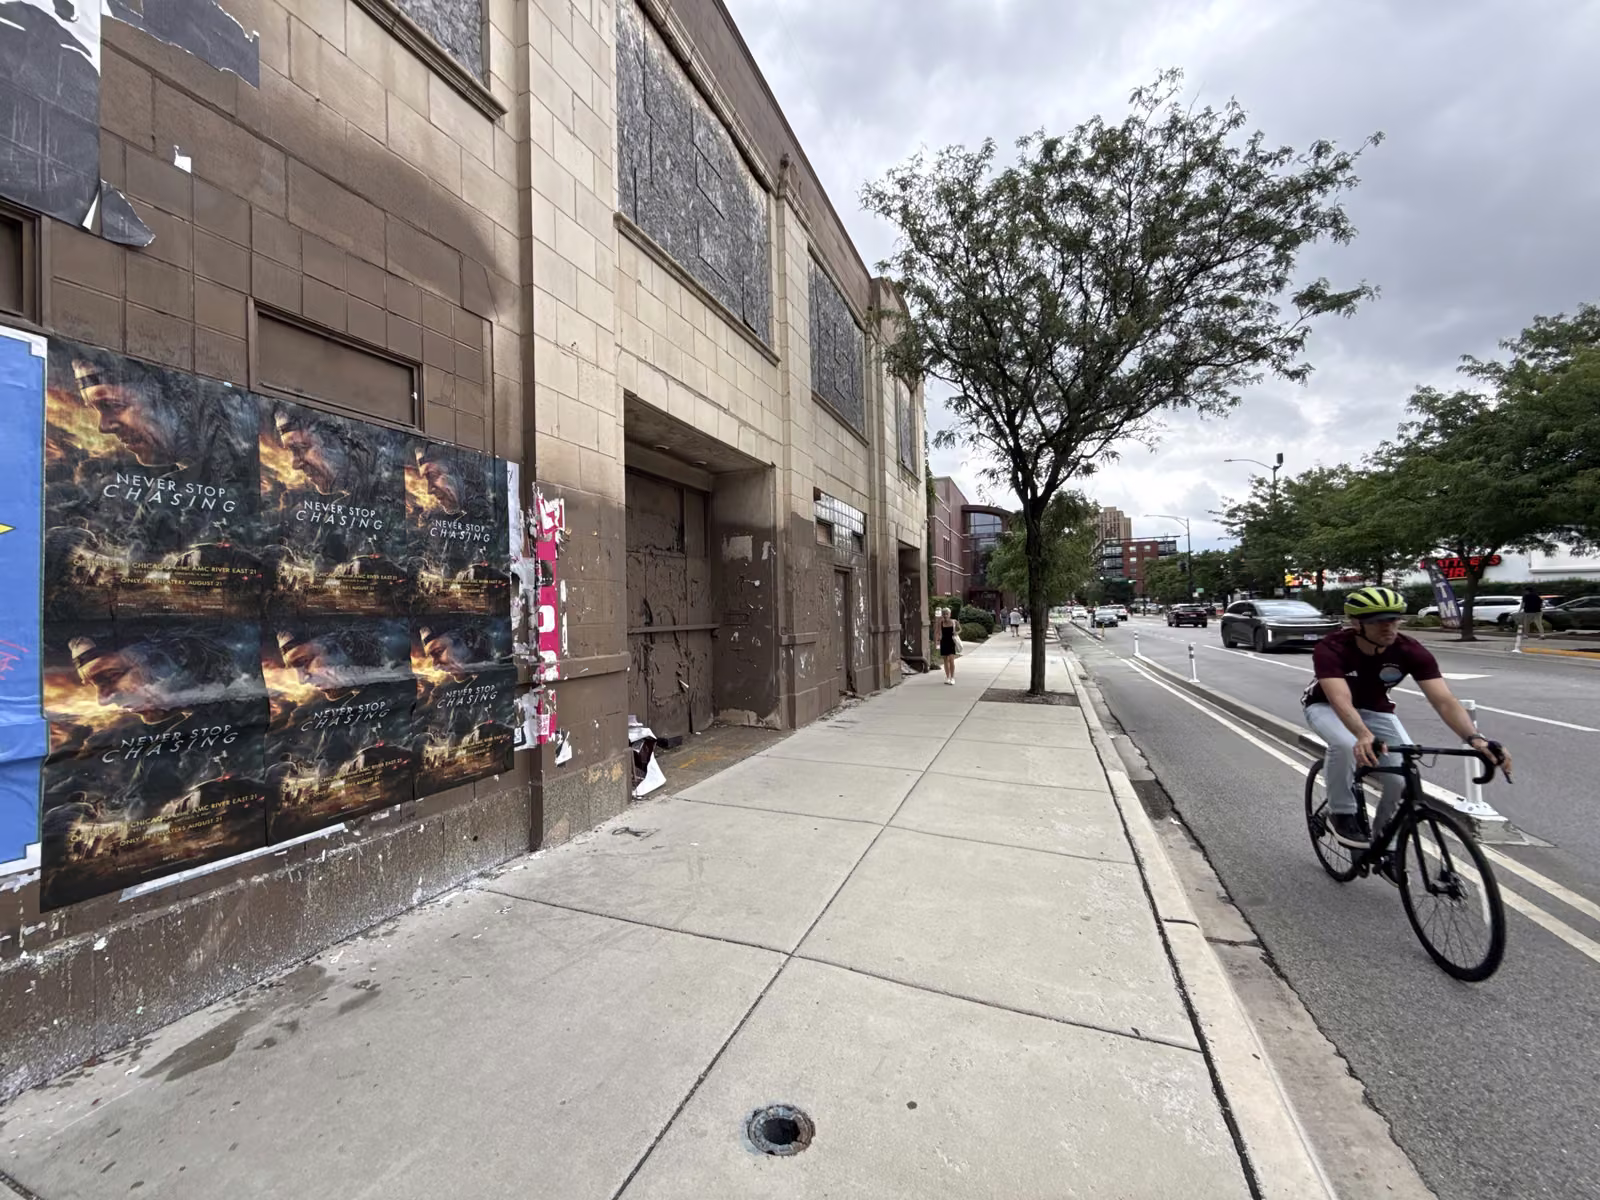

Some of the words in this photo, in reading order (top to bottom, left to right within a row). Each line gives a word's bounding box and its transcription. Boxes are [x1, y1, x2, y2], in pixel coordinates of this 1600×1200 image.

[116, 472, 176, 491] NEVER
[185, 483, 226, 498] STOP
[103, 484, 236, 513] CHASING
[303, 500, 343, 514] NEVER
[349, 506, 376, 518] STOP
[296, 510, 383, 530] CHASING
[435, 519, 462, 530] NEVER
[465, 523, 485, 533] STOP
[430, 527, 490, 543] CHASING
[132, 562, 171, 571] CHICAGO
[436, 691, 498, 709] CHASING
[446, 687, 473, 699] NEVER
[476, 684, 496, 694] STOP
[301, 709, 390, 732] CHASING
[313, 706, 353, 720] NEVER
[358, 701, 386, 713] STOP
[120, 732, 182, 748] NEVER
[190, 724, 232, 739] STOP
[102, 732, 239, 763] CHASING
[130, 814, 170, 828] CHICAGO
[192, 805, 210, 814] AMC
[211, 800, 231, 809] RIVER
[232, 796, 249, 805] EAST
[249, 793, 258, 801] 21
[119, 836, 141, 847] ONLY
[188, 818, 214, 830] AUGUST
